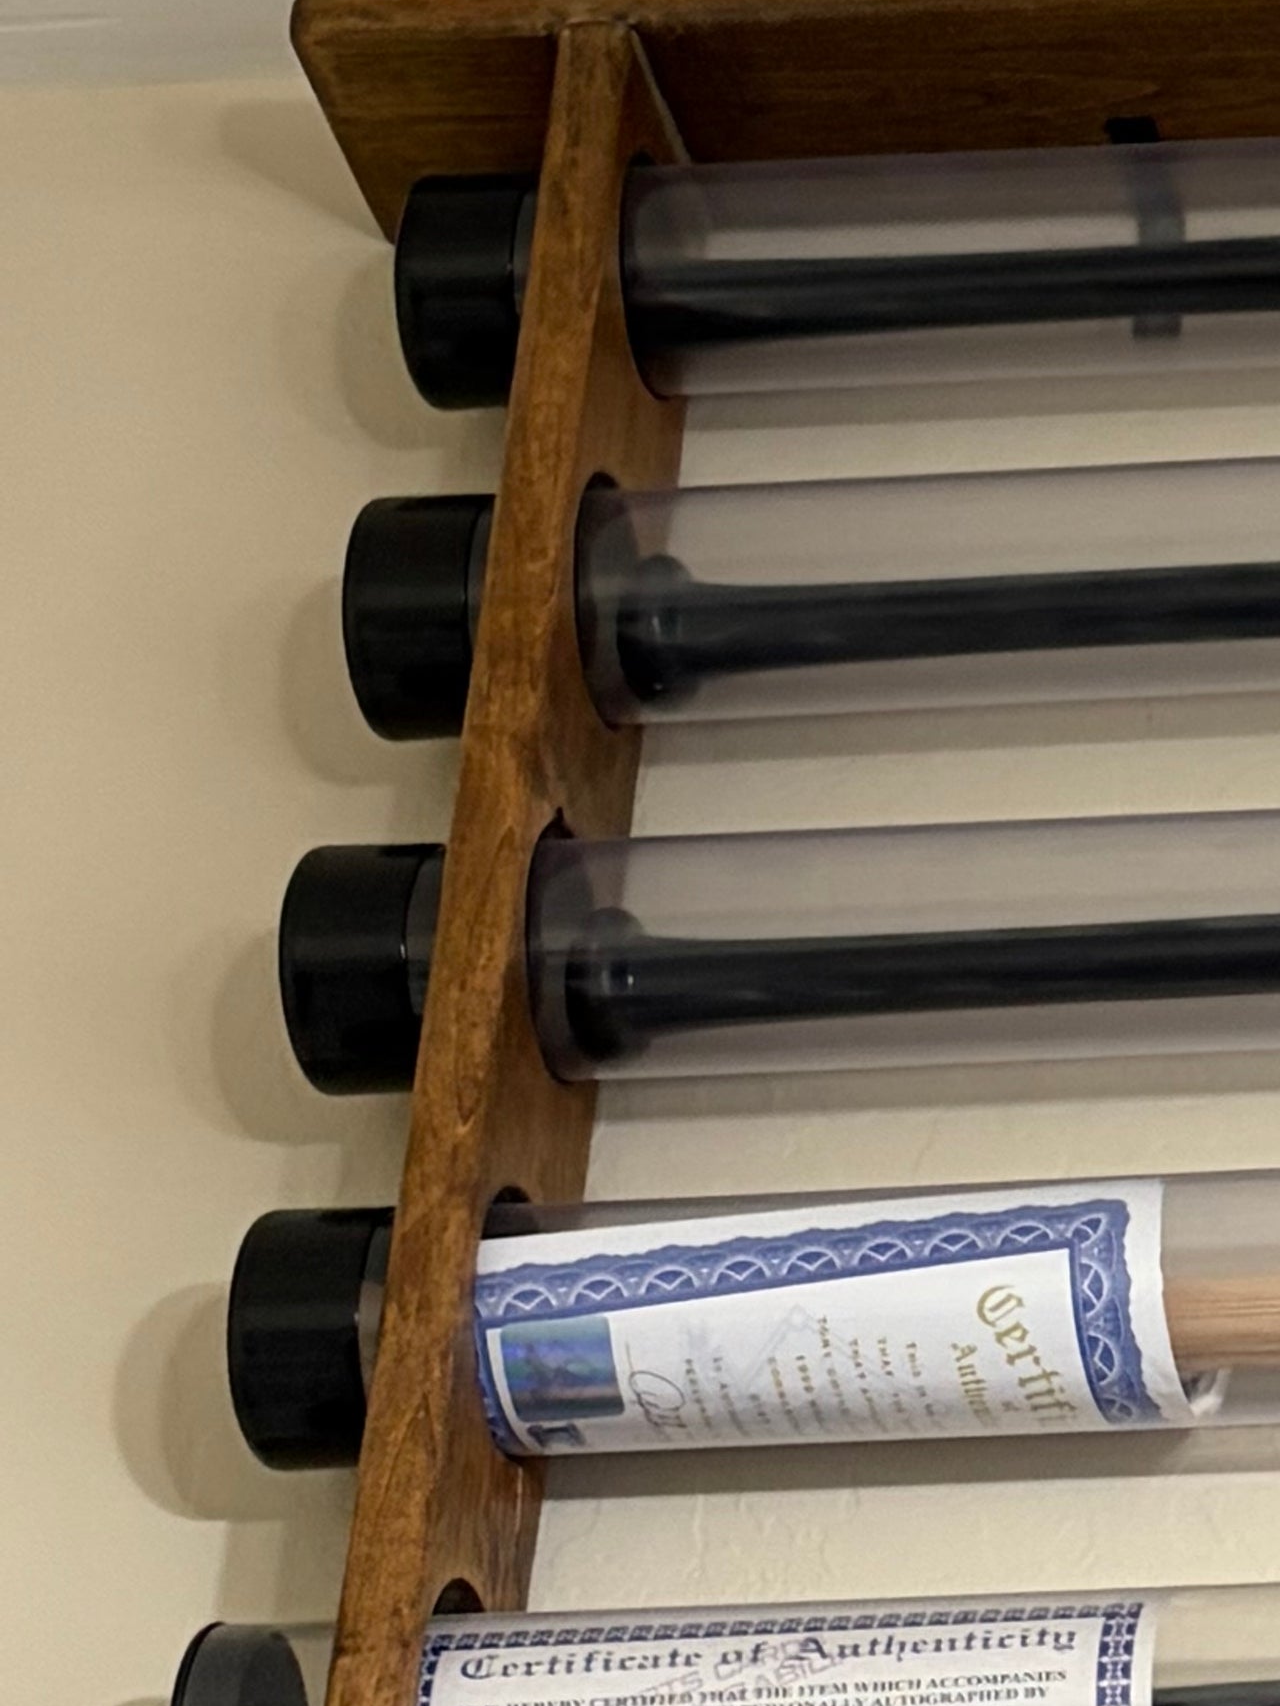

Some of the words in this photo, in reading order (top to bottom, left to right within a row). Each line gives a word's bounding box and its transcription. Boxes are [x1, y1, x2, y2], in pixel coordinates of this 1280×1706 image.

[460, 1647, 704, 1680] Certificate
[721, 1641, 770, 1666] of
[793, 1626, 1078, 1661] Authenticity
[854, 1677, 922, 1695] WHICH
[926, 1669, 1067, 1690] ACCOMPANIES
